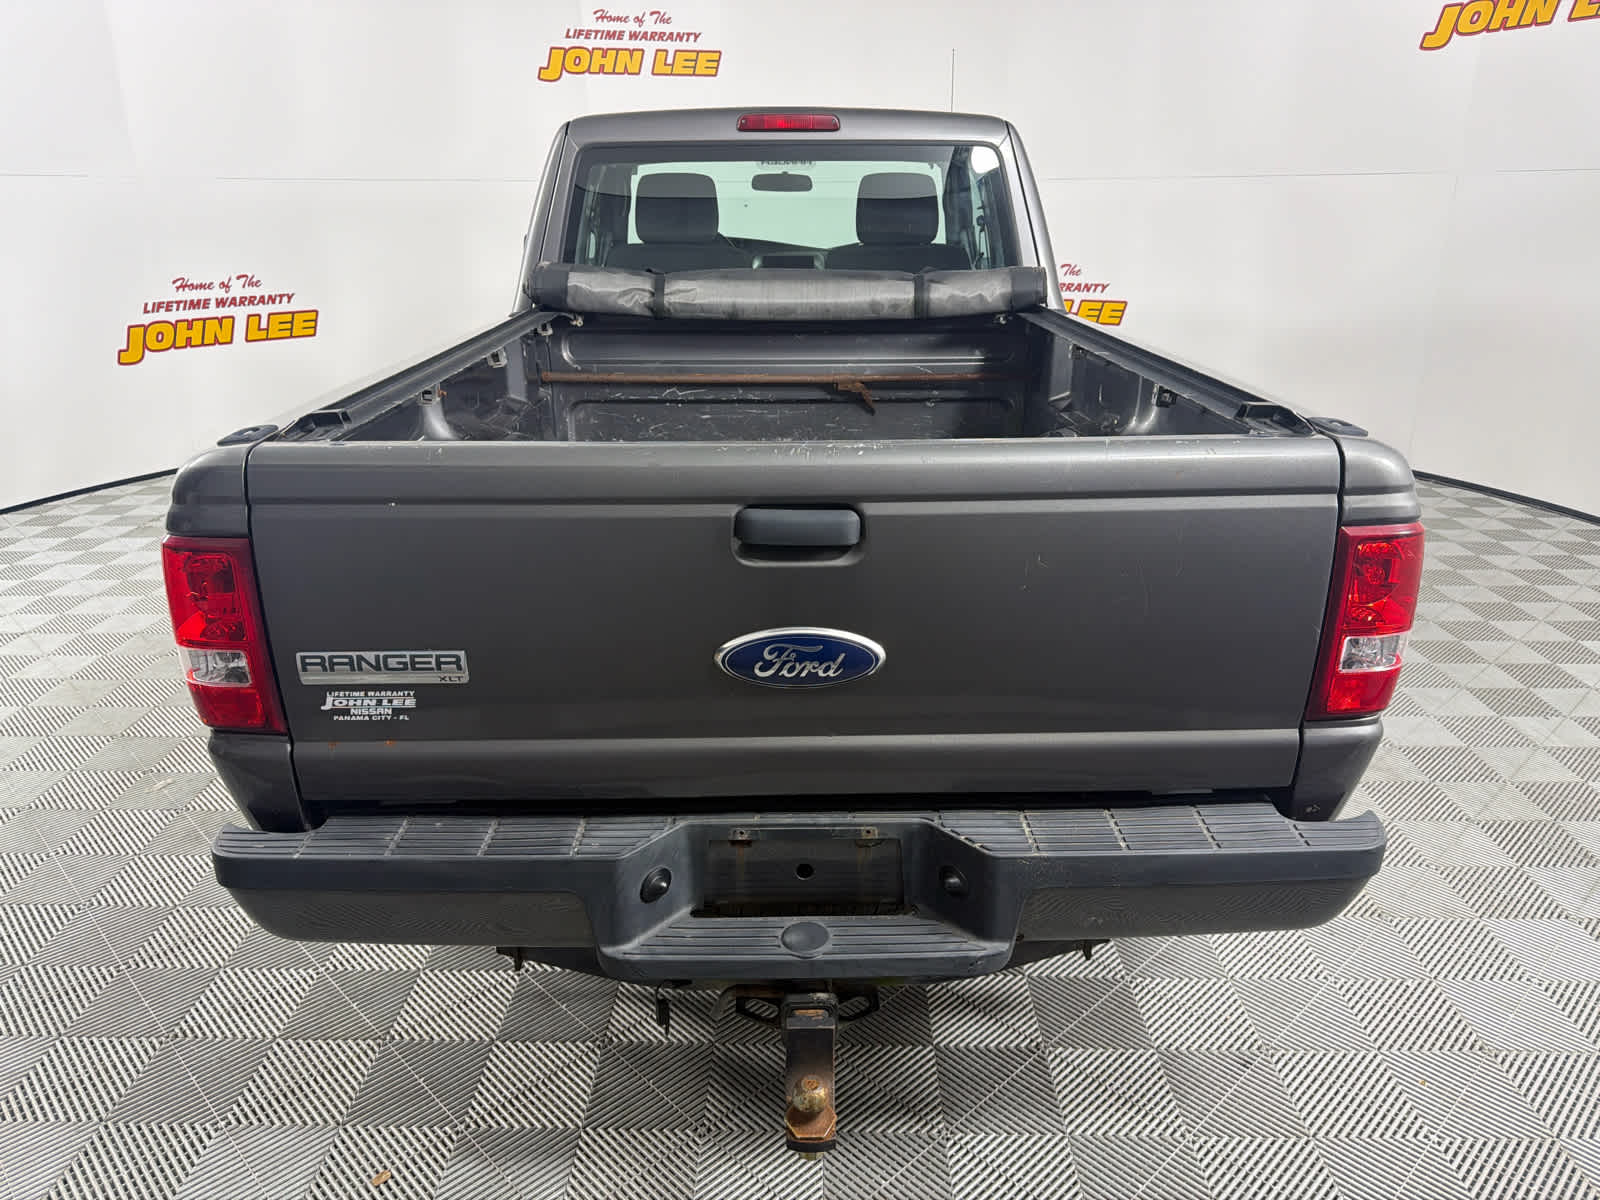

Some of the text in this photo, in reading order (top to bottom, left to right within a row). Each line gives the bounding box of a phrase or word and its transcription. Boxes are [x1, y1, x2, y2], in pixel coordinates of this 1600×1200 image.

[593, 9, 673, 27] Home of The
[1419, 0, 1560, 51] JOHN
[565, 28, 701, 42] LIFETIME WARRANTY
[538, 46, 721, 82] JOHN LEE
[1061, 264, 1082, 276] The
[172, 274, 262, 294] Home of The
[1058, 282, 1110, 293] RRANTY
[143, 293, 295, 314] LIFETIME WARRANTY
[118, 309, 318, 366] JOHN LEE
[300, 654, 463, 672] RANGER
[754, 643, 846, 678] Ford
[320, 696, 416, 710] JOHN LEE
